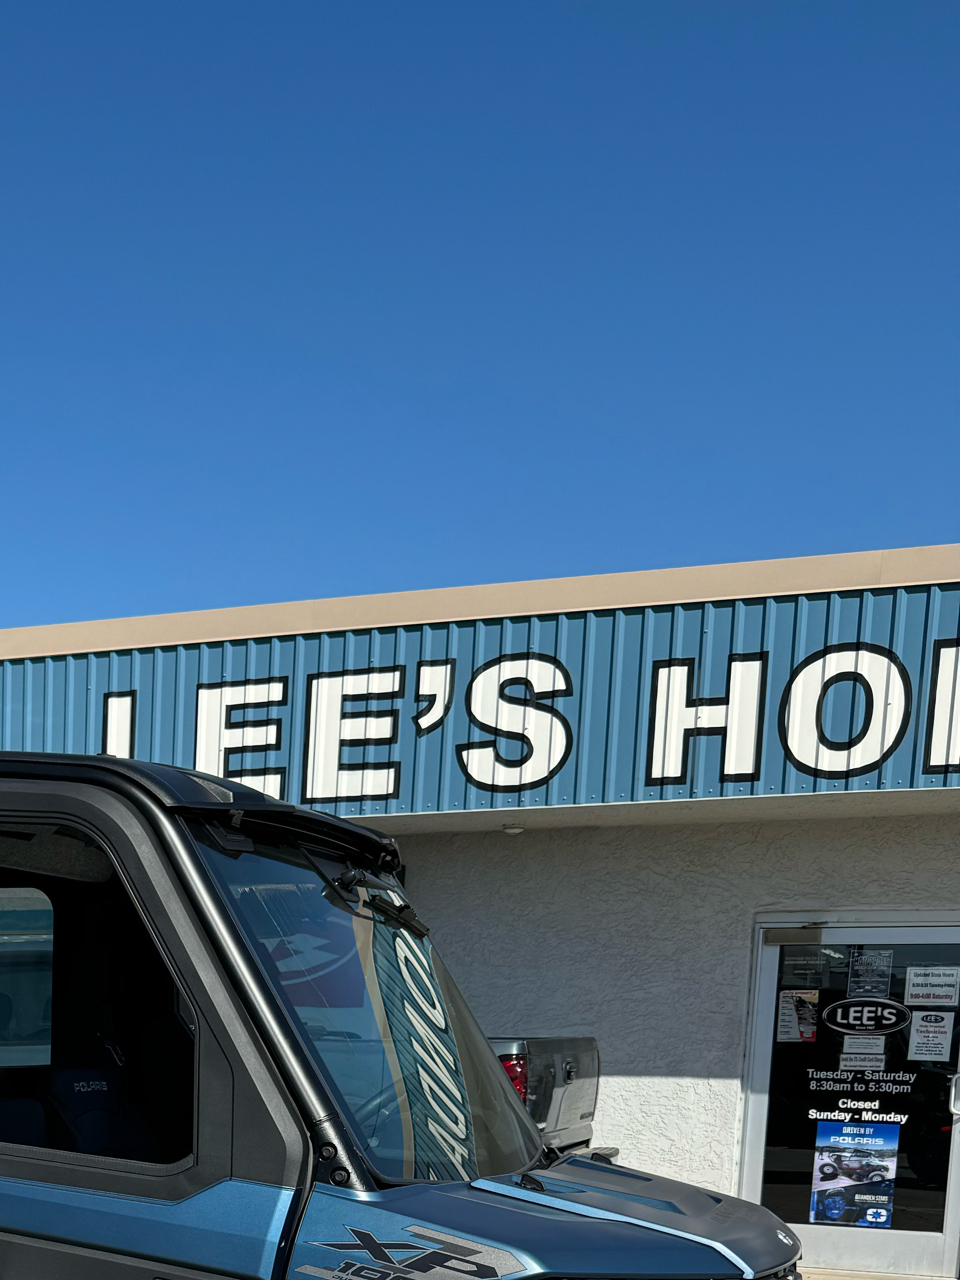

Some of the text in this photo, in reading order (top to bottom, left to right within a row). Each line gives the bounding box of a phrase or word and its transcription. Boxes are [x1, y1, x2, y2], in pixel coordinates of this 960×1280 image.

[836, 1006, 897, 1025] LEE'S
[807, 1069, 855, 1081] Tuesday
[864, 1070, 917, 1083] Saturday
[809, 1080, 912, 1094] 8:30am to 5:30pm
[838, 1098, 880, 1110] Closed
[808, 1109, 853, 1122] Sunday
[861, 1111, 909, 1125] Monday
[842, 1126, 874, 1135] DRIVEN BY
[830, 1136, 884, 1145] POLARIS
[308, 1223, 503, 1280] XP
